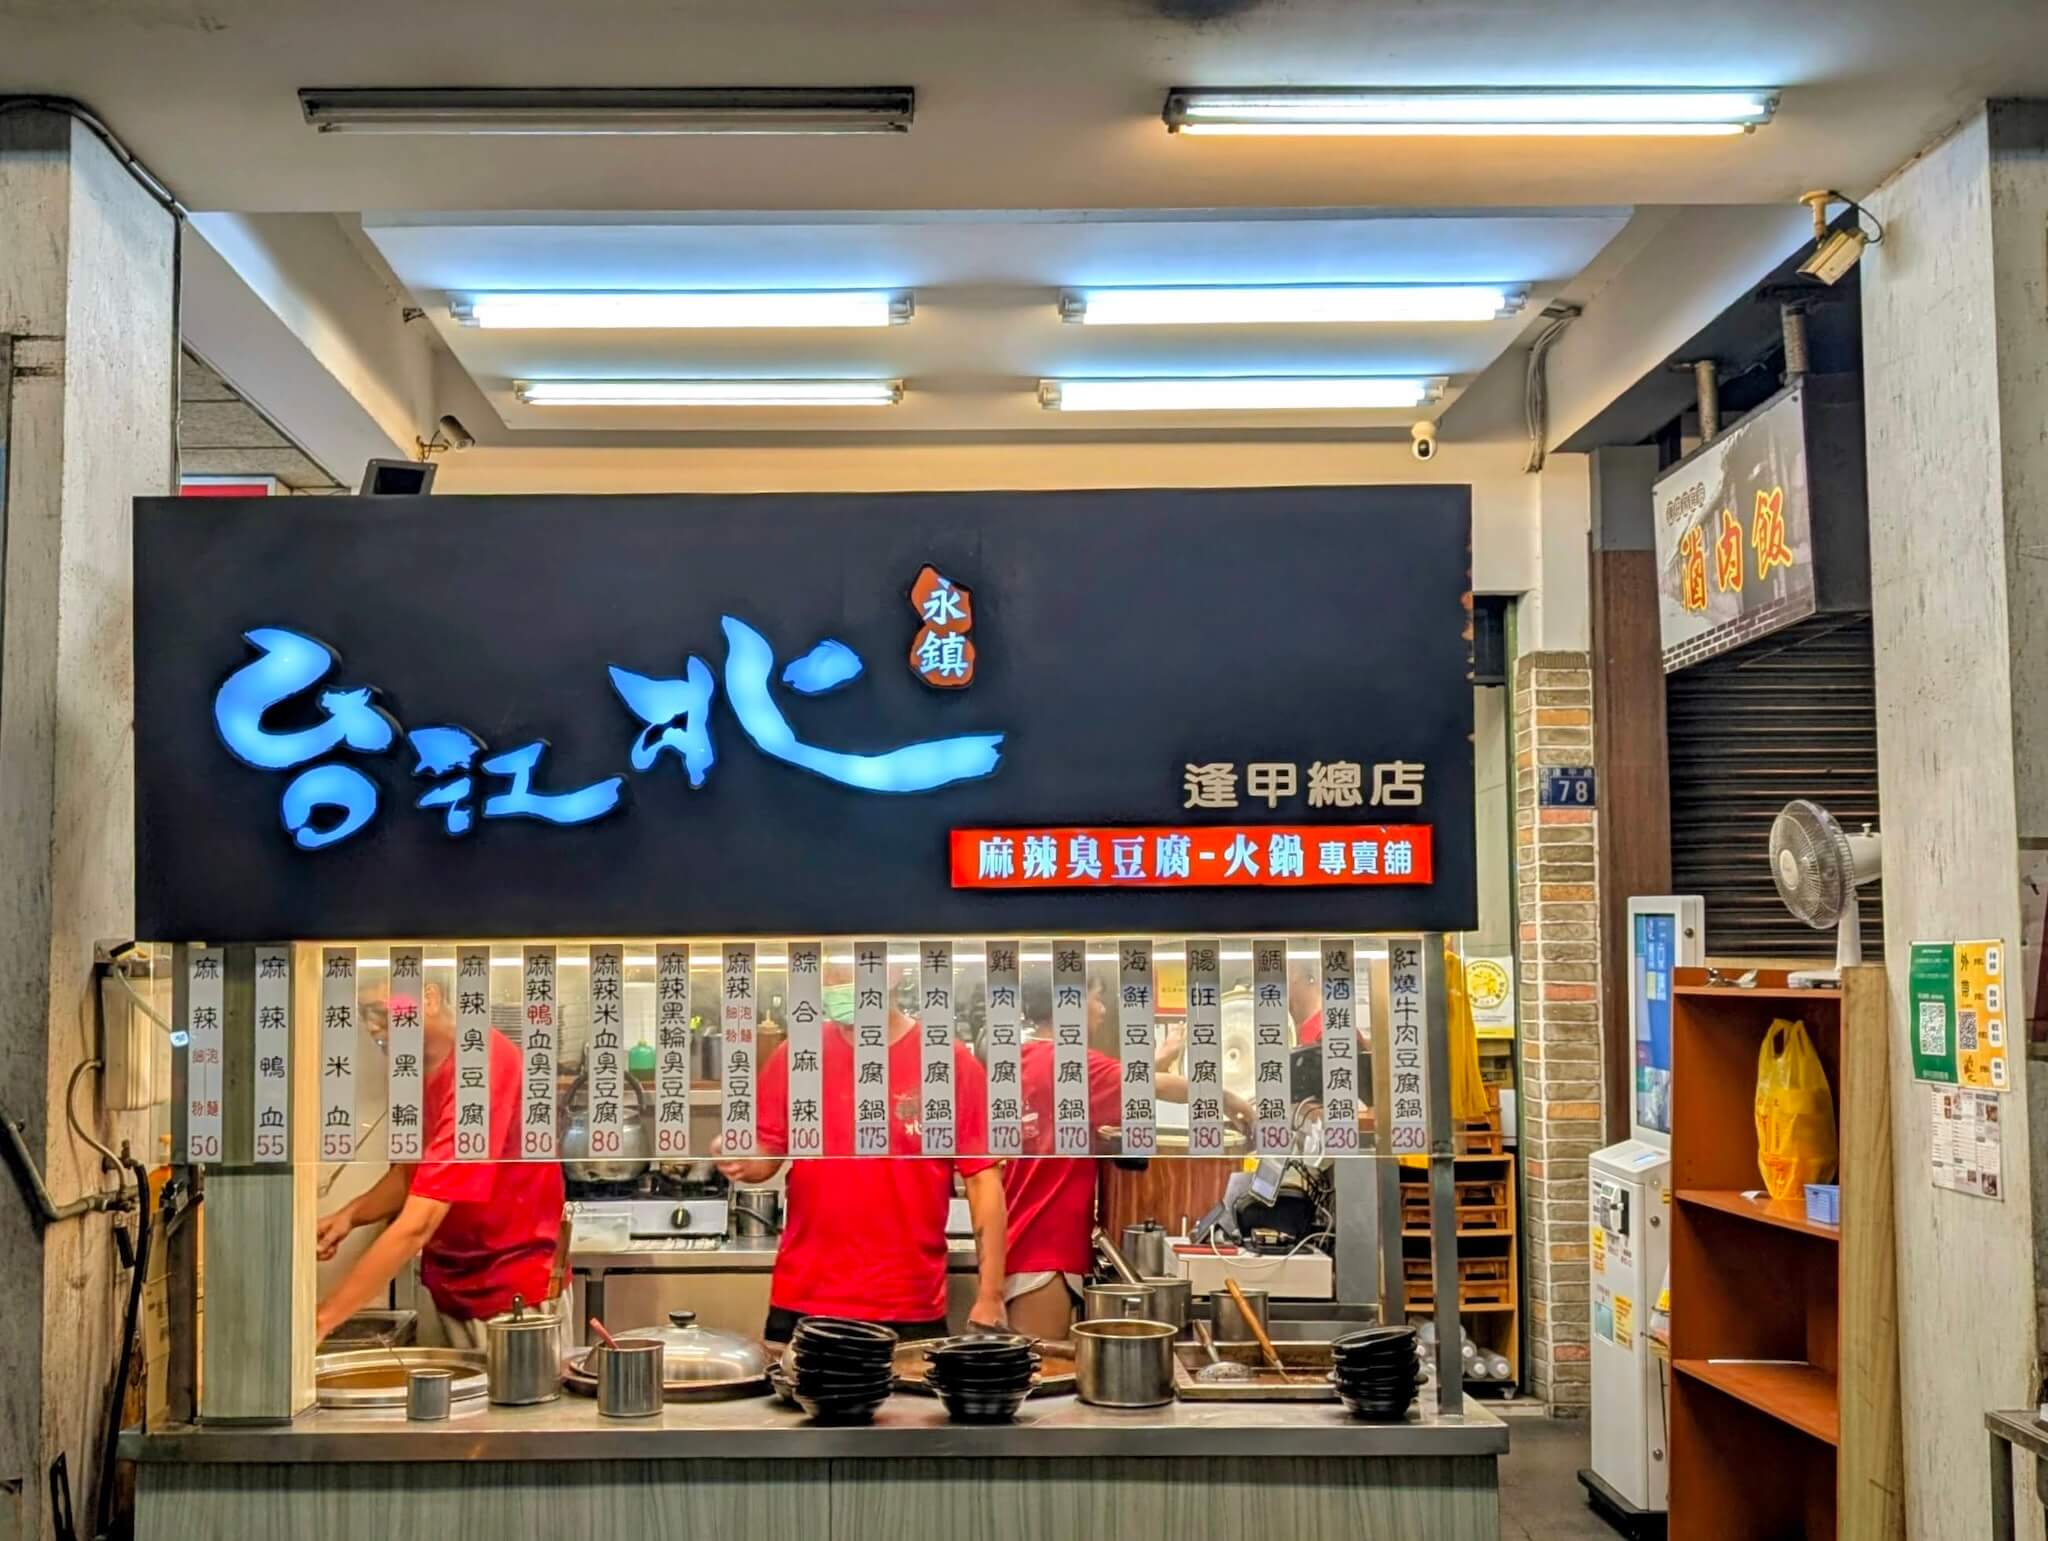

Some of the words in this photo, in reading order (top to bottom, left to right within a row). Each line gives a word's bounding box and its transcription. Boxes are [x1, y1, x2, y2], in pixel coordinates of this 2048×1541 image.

[917, 577, 968, 677] 永鎮
[1184, 761, 1426, 808] 逢甲總店
[1559, 780, 1588, 802] 78
[193, 957, 218, 1029] 麻辣
[726, 952, 752, 1000] 麻辣
[259, 956, 286, 1128] 麻辣鴨血
[325, 956, 353, 1127] 麻辣米血
[392, 956, 419, 1127] 麻辣黑輪
[459, 955, 486, 1127] 麻辣臭豆腐
[526, 954, 553, 1125] 麻辣鴨血臭豆腐
[593, 953, 620, 1125] 麻辣米血臭豆腐
[659, 952, 686, 1124] 麻辣黑輪臭豆腐
[791, 952, 819, 1122] 綜合麻辣
[858, 952, 885, 1121] 牛肉豆腐鍋
[924, 951, 952, 1121] 羊肉豆腐鍋
[990, 951, 1018, 1120] 雞肉豆腐鍋
[1056, 951, 1085, 1120] 豬肉豆腐鍋
[1123, 950, 1153, 1120] 海鮮豆腐鍋
[1190, 950, 1219, 1120] 腸旺豆腐鍋
[1258, 950, 1286, 1120] 鯛魚豆腐鍋
[1326, 951, 1355, 1120] 燒酒雞豆腐鍋
[1392, 948, 1422, 1120] 紅燒牛肉豆腐鍋
[727, 1051, 752, 1123] 臭豆腐
[191, 1136, 218, 1157] 50
[257, 1135, 285, 1156] 55
[324, 1135, 352, 1156] 55
[391, 1134, 419, 1155] 55
[458, 1132, 485, 1154] 80
[525, 1131, 552, 1153] 80
[591, 1130, 620, 1152] 80
[658, 1129, 686, 1151] 80
[725, 1129, 752, 1151] 80
[791, 1128, 820, 1149] 100
[859, 1127, 887, 1149] 175
[925, 1127, 953, 1148] 175
[992, 1127, 1021, 1148] 170
[1058, 1127, 1087, 1148] 170
[1125, 1127, 1153, 1148] 185
[1192, 1127, 1221, 1148] 180
[1262, 1127, 1290, 1148] 180
[1325, 1127, 1357, 1148] 230
[1392, 1127, 1425, 1148] 230
